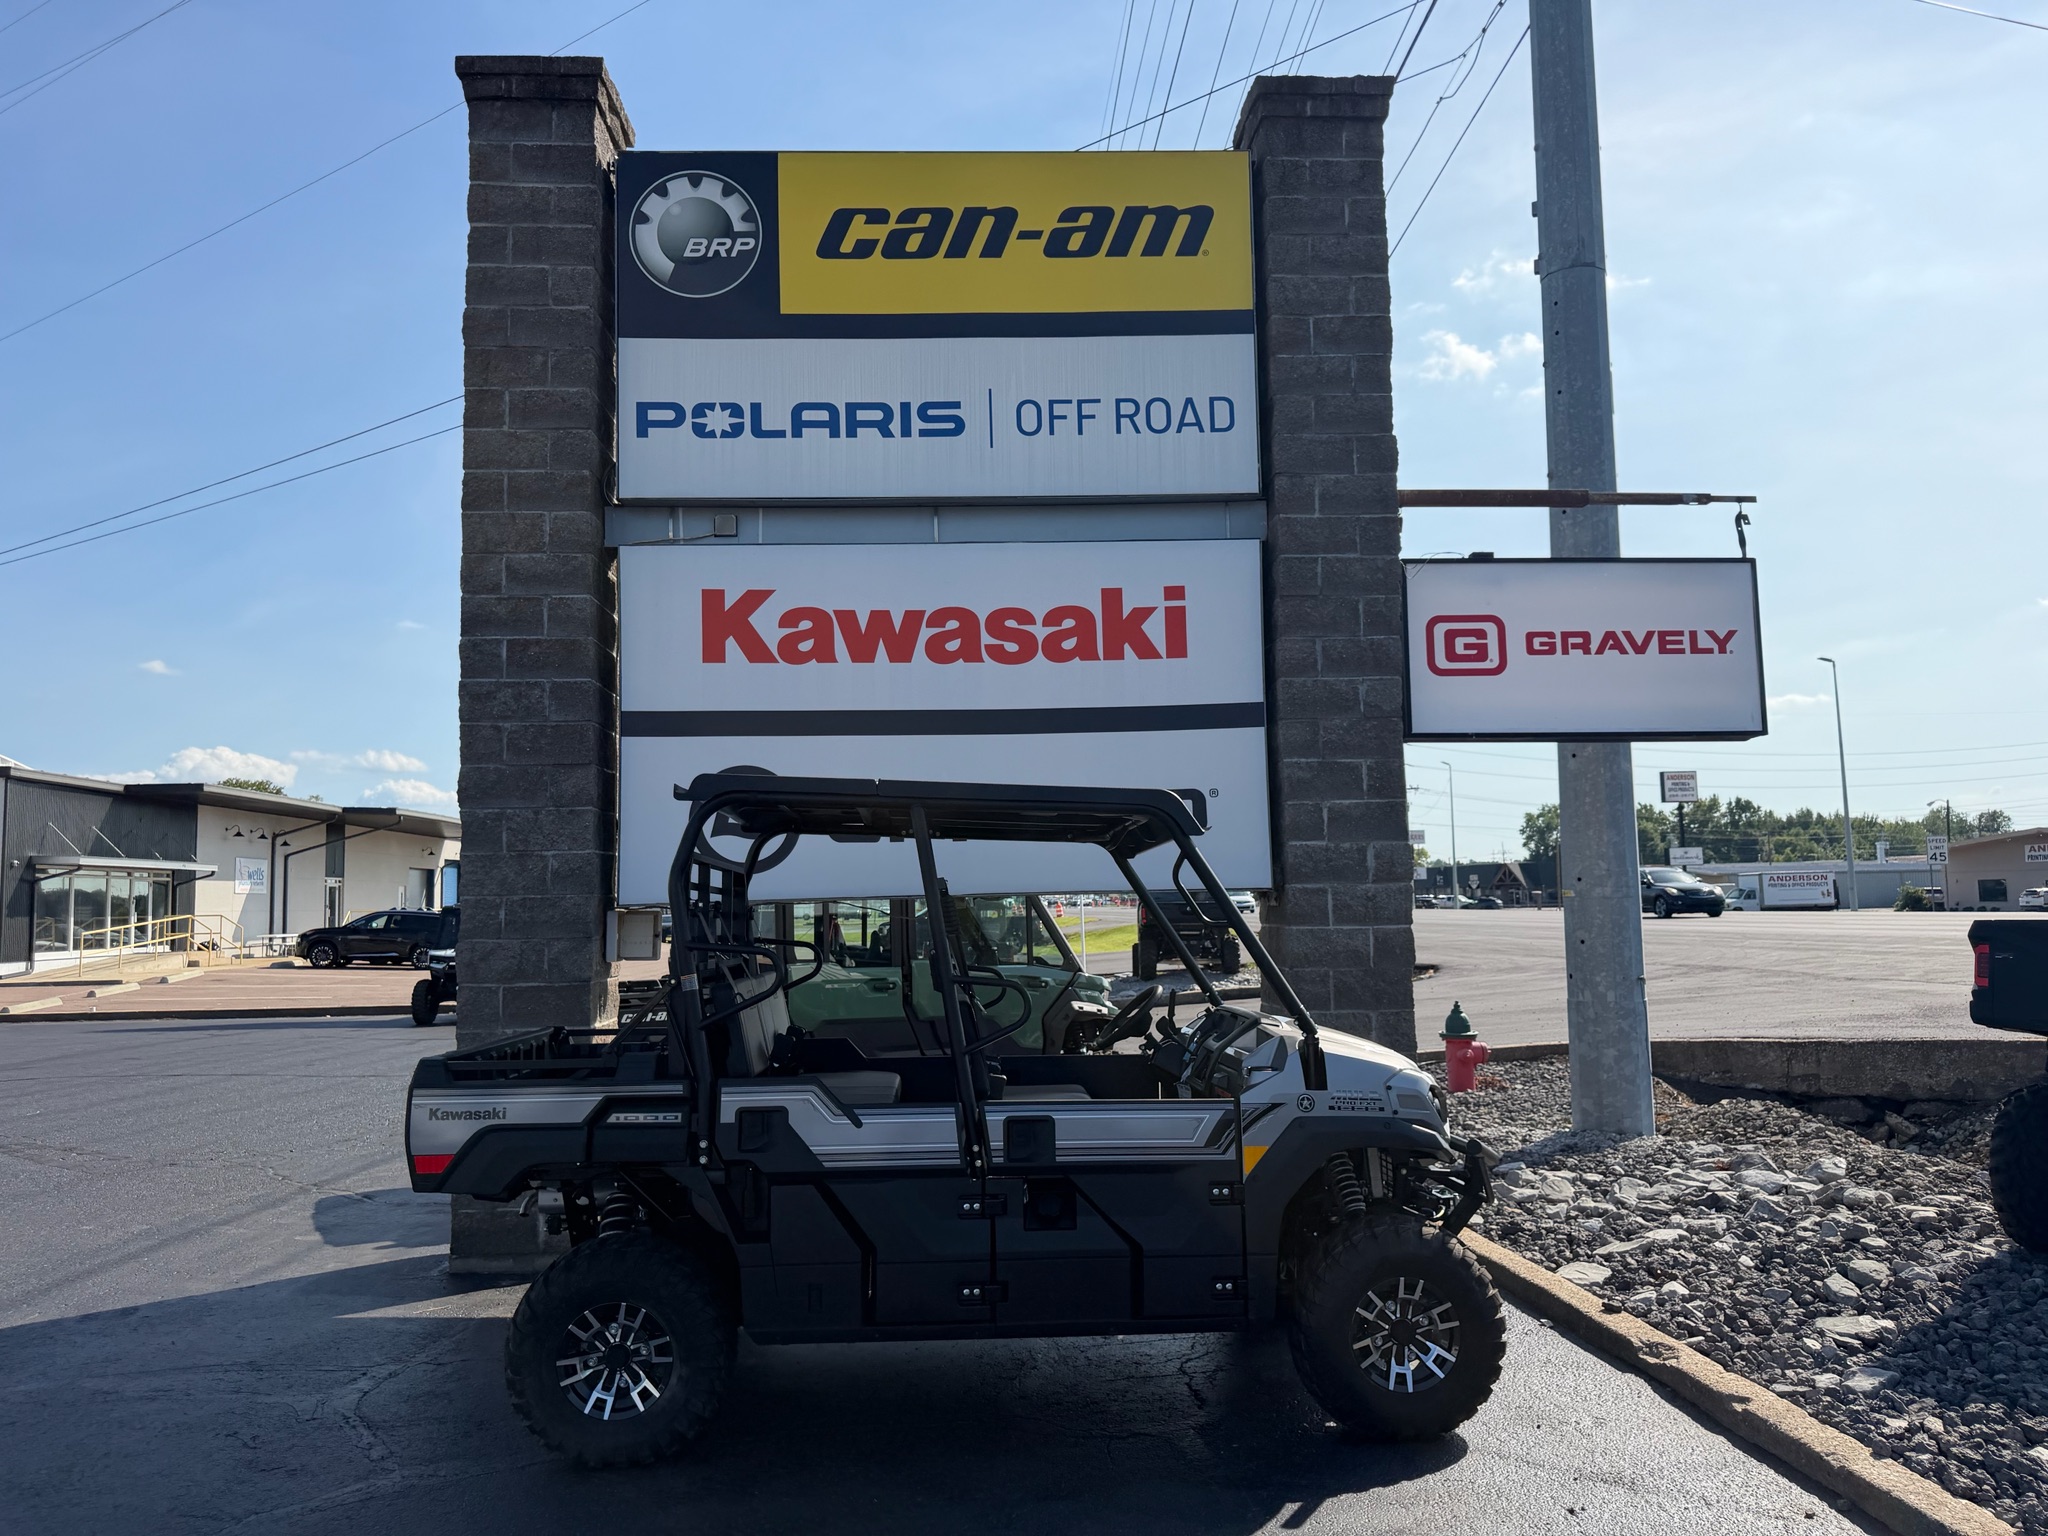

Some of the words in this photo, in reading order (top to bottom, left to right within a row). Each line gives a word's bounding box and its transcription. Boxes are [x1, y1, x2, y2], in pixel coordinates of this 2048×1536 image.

[815, 205, 1215, 260] can-am
[683, 237, 755, 259] BRP
[635, 400, 967, 440] POLARIS
[1015, 398, 1102, 438] OFF
[1115, 395, 1236, 435] ROAD
[701, 585, 1189, 666] Kawasaki
[1525, 629, 1739, 656] GRAVELY
[1929, 852, 1947, 862] 45
[2028, 844, 2048, 853] AN
[1768, 874, 1828, 882] ANDERSON
[428, 1107, 507, 1121] Kawasaki
